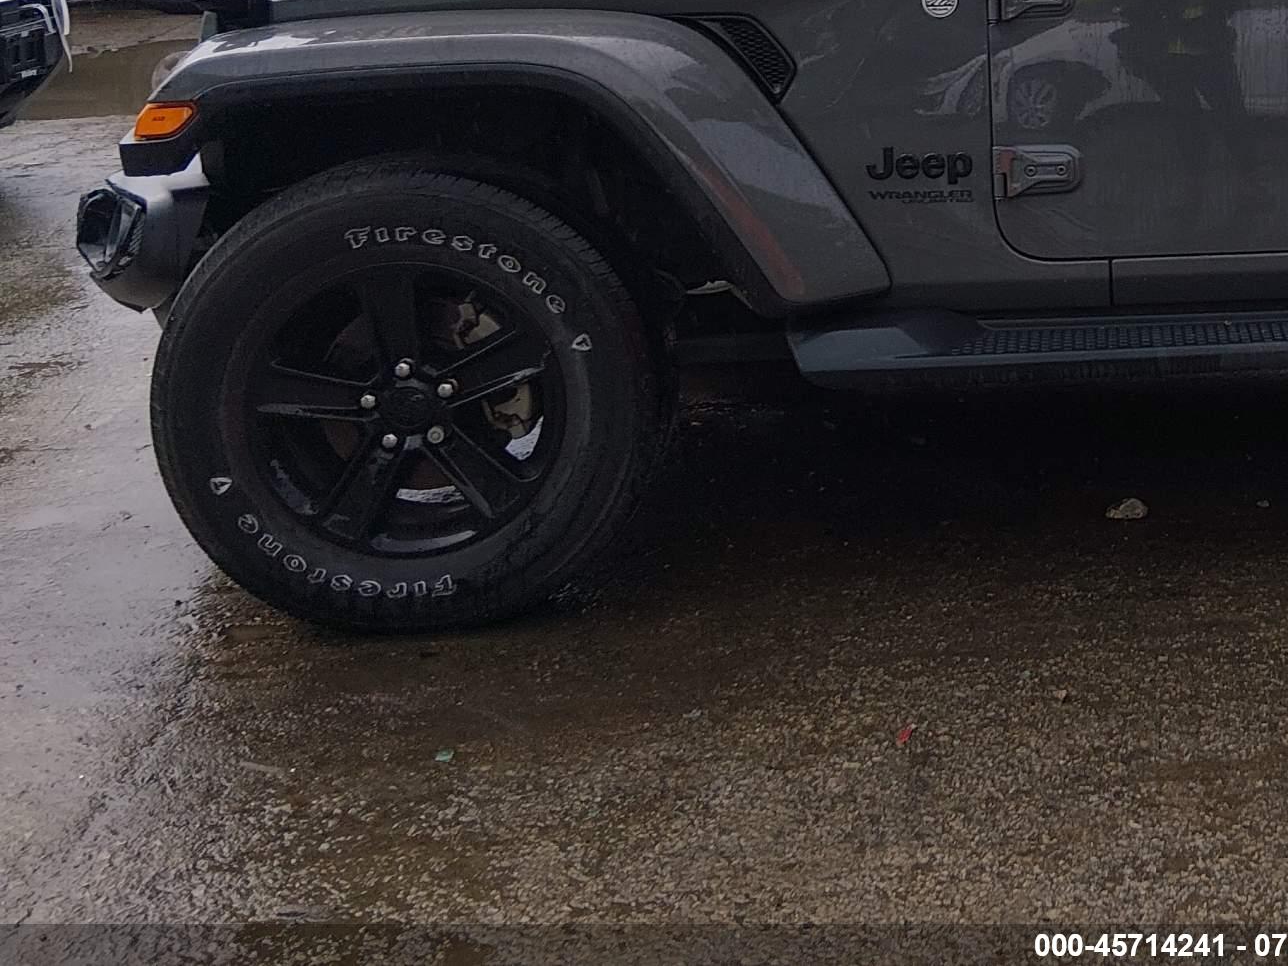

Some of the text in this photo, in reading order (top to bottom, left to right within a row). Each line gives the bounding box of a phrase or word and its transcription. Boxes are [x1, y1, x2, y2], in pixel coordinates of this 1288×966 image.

[865, 146, 974, 185] Jeep
[866, 190, 973, 200] WRANGLER
[344, 226, 567, 314] Firestone
[238, 513, 458, 598] Firestone
